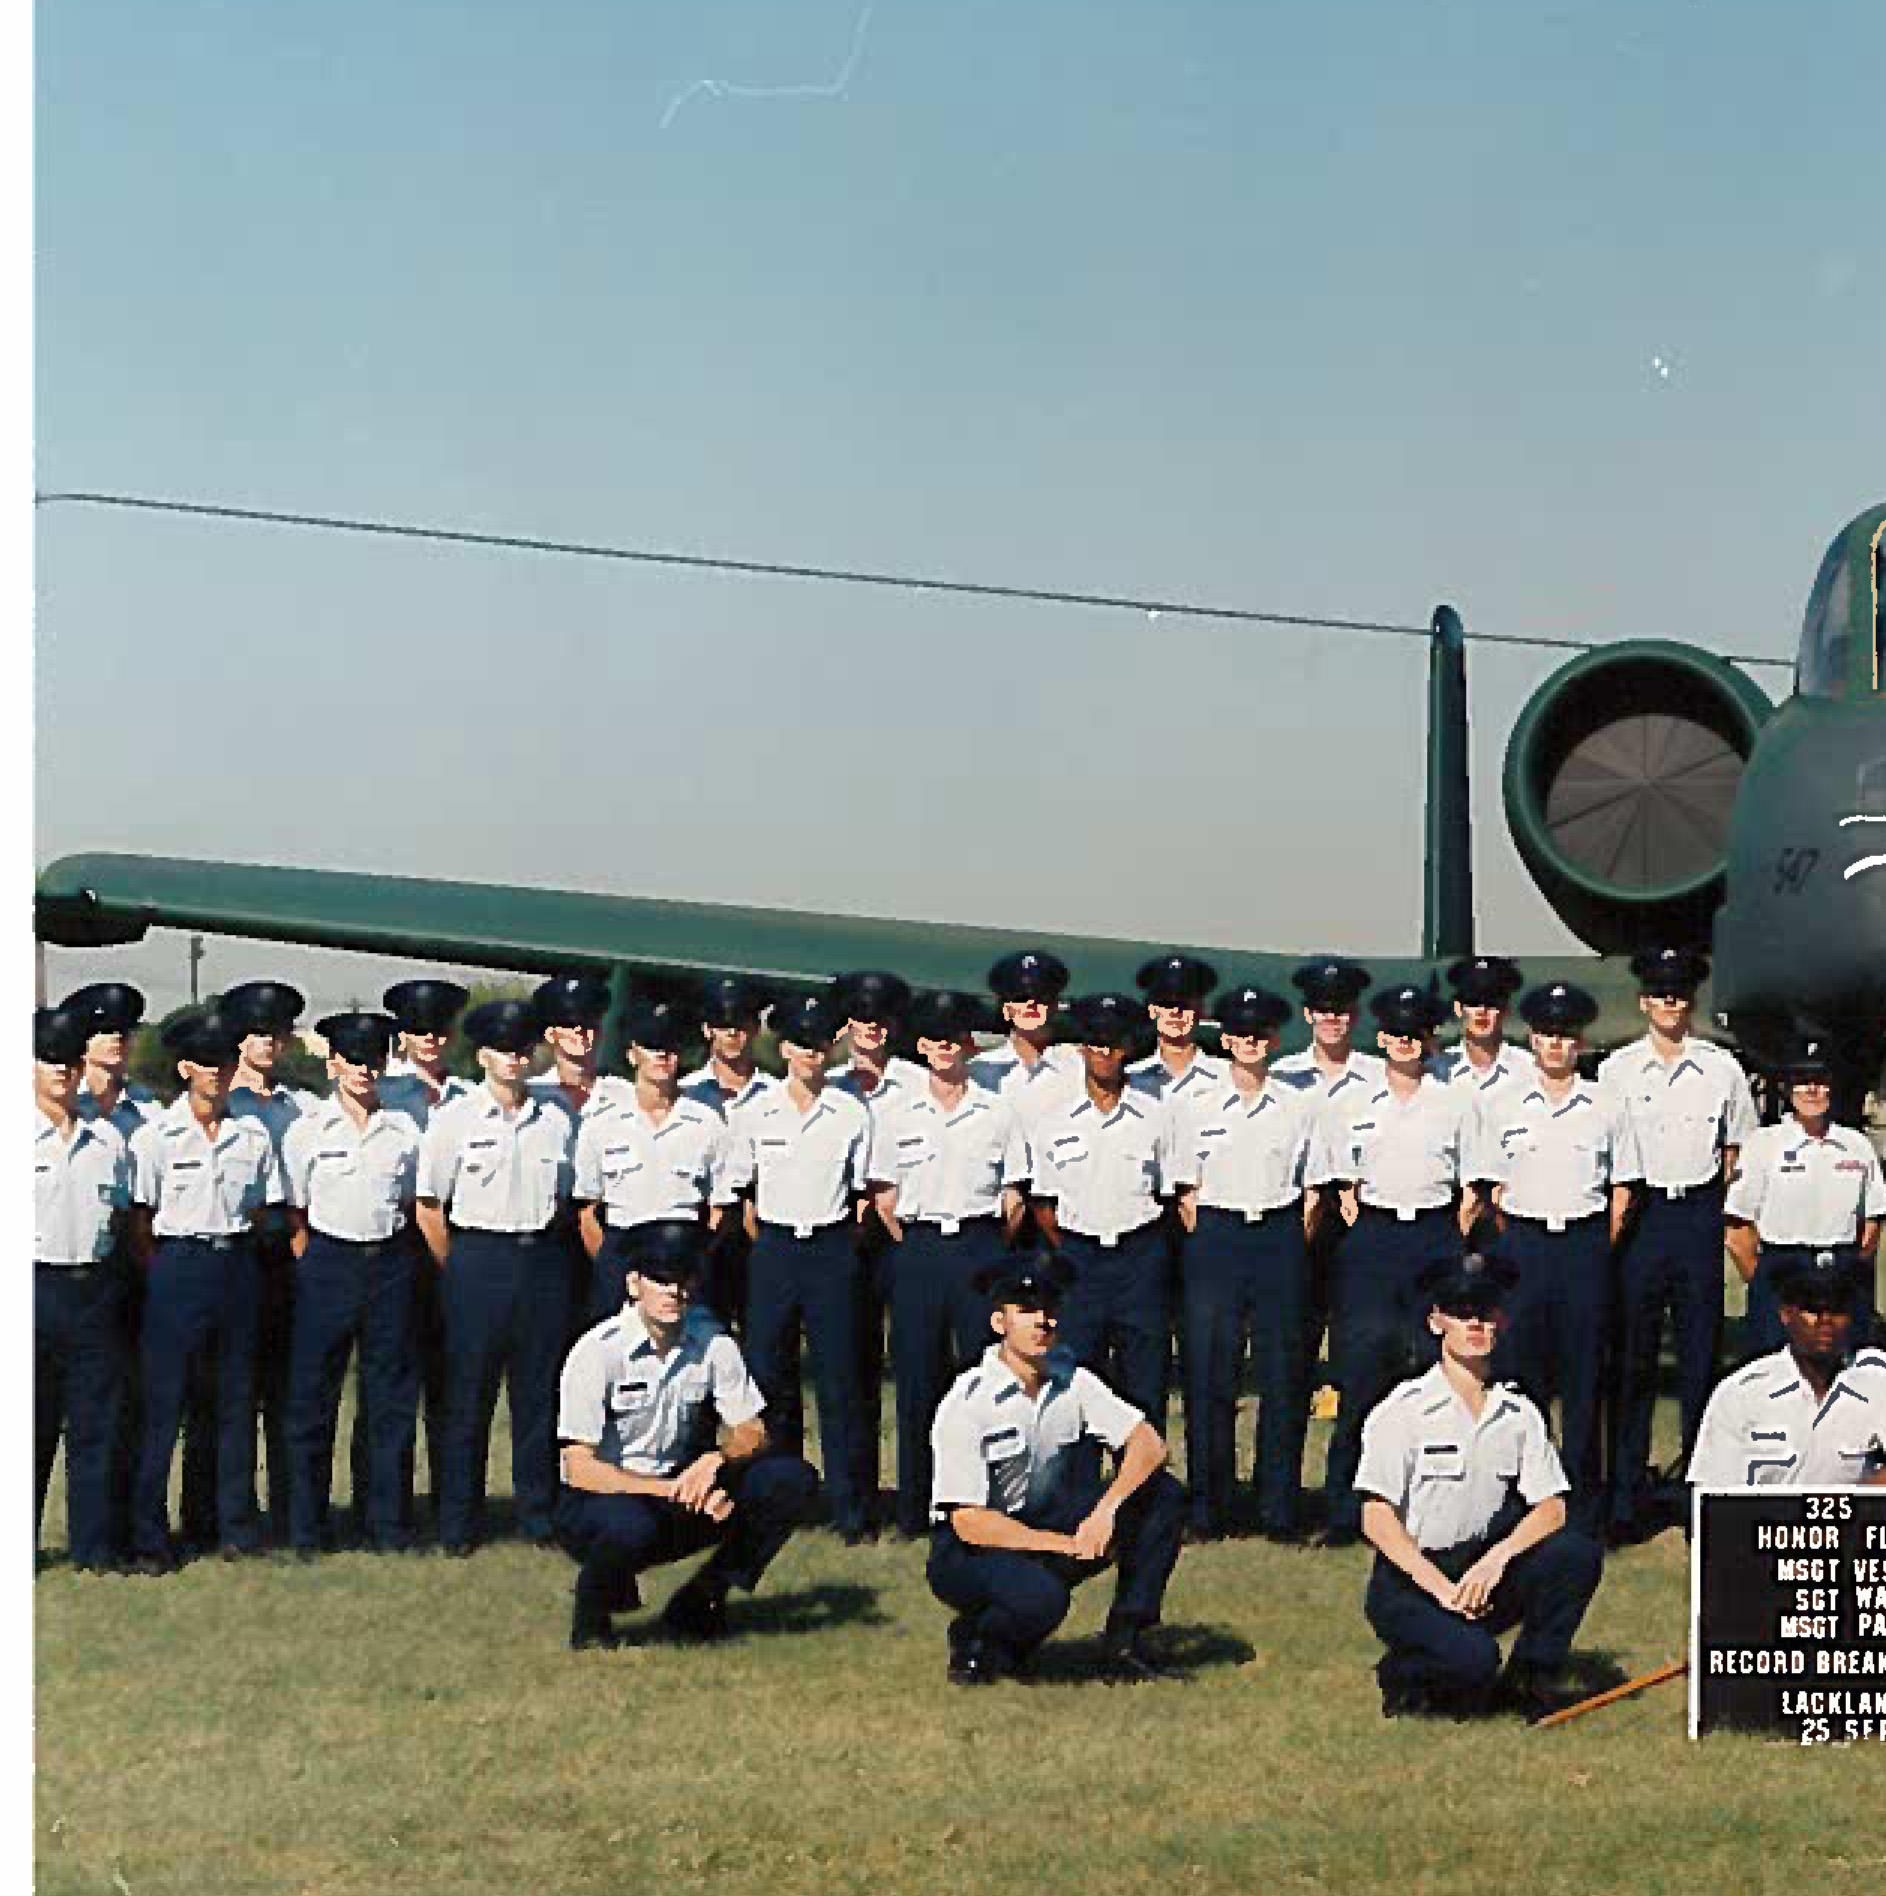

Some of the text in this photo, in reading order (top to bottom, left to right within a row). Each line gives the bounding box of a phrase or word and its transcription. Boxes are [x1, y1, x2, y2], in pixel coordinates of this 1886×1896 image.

[1806, 1497, 1853, 1520] 325
[1758, 1525, 1839, 1550] HONOR
[1777, 1558, 1840, 1583] MSGT
[1796, 1588, 1839, 1611] SGT
[1780, 1615, 1839, 1640] MSGT
[1710, 1650, 1805, 1674] RECORD
[1801, 1718, 1830, 1746] 25
